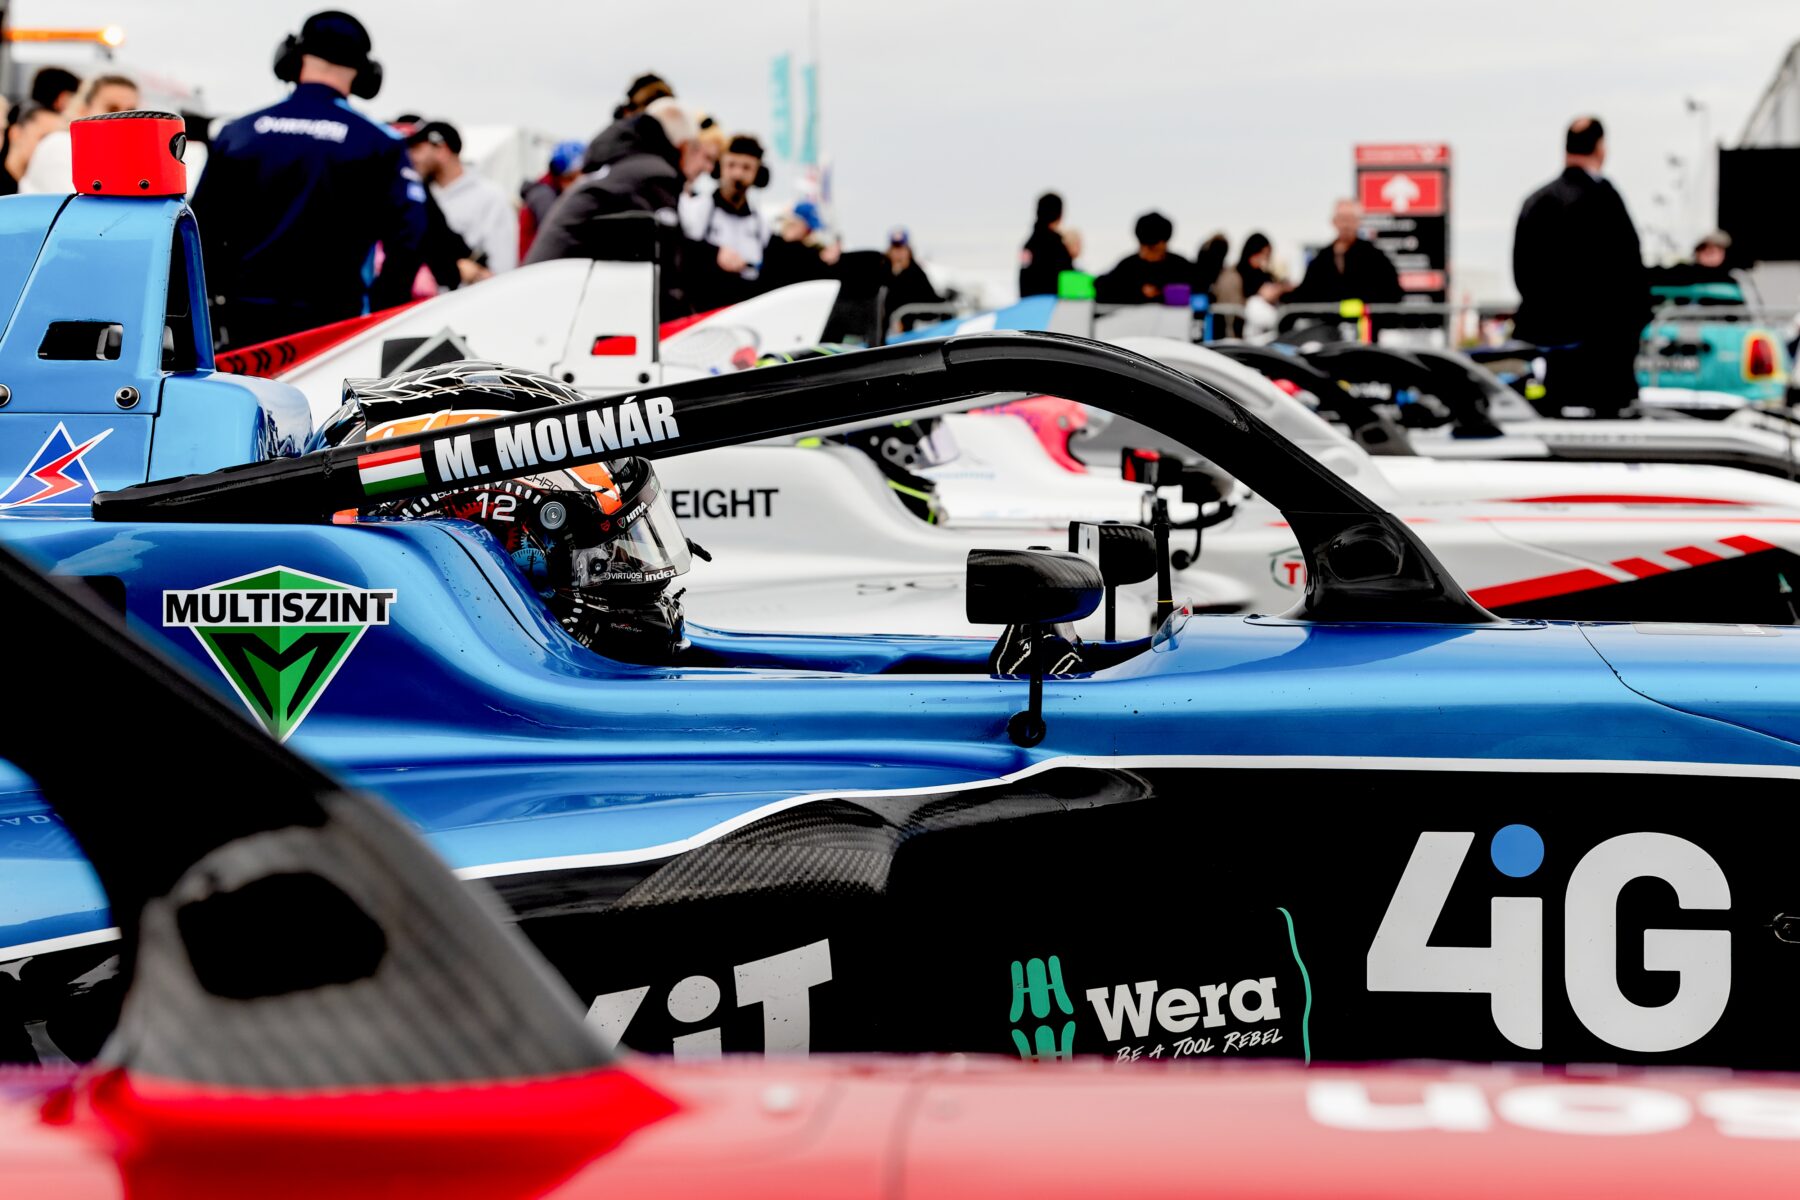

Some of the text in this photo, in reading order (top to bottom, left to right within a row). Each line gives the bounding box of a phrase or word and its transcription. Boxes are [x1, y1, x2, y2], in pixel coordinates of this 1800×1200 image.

[434, 396, 680, 482] M. MOLNÁR
[476, 492, 517, 522] 12
[665, 488, 779, 519] EIGHT
[645, 568, 677, 583] index
[165, 592, 394, 624] MULTISZINT
[1367, 824, 1732, 1053] 4iG
[1086, 977, 1281, 1041] Wera
[1116, 1028, 1283, 1063] BE A TOOL REBEL
